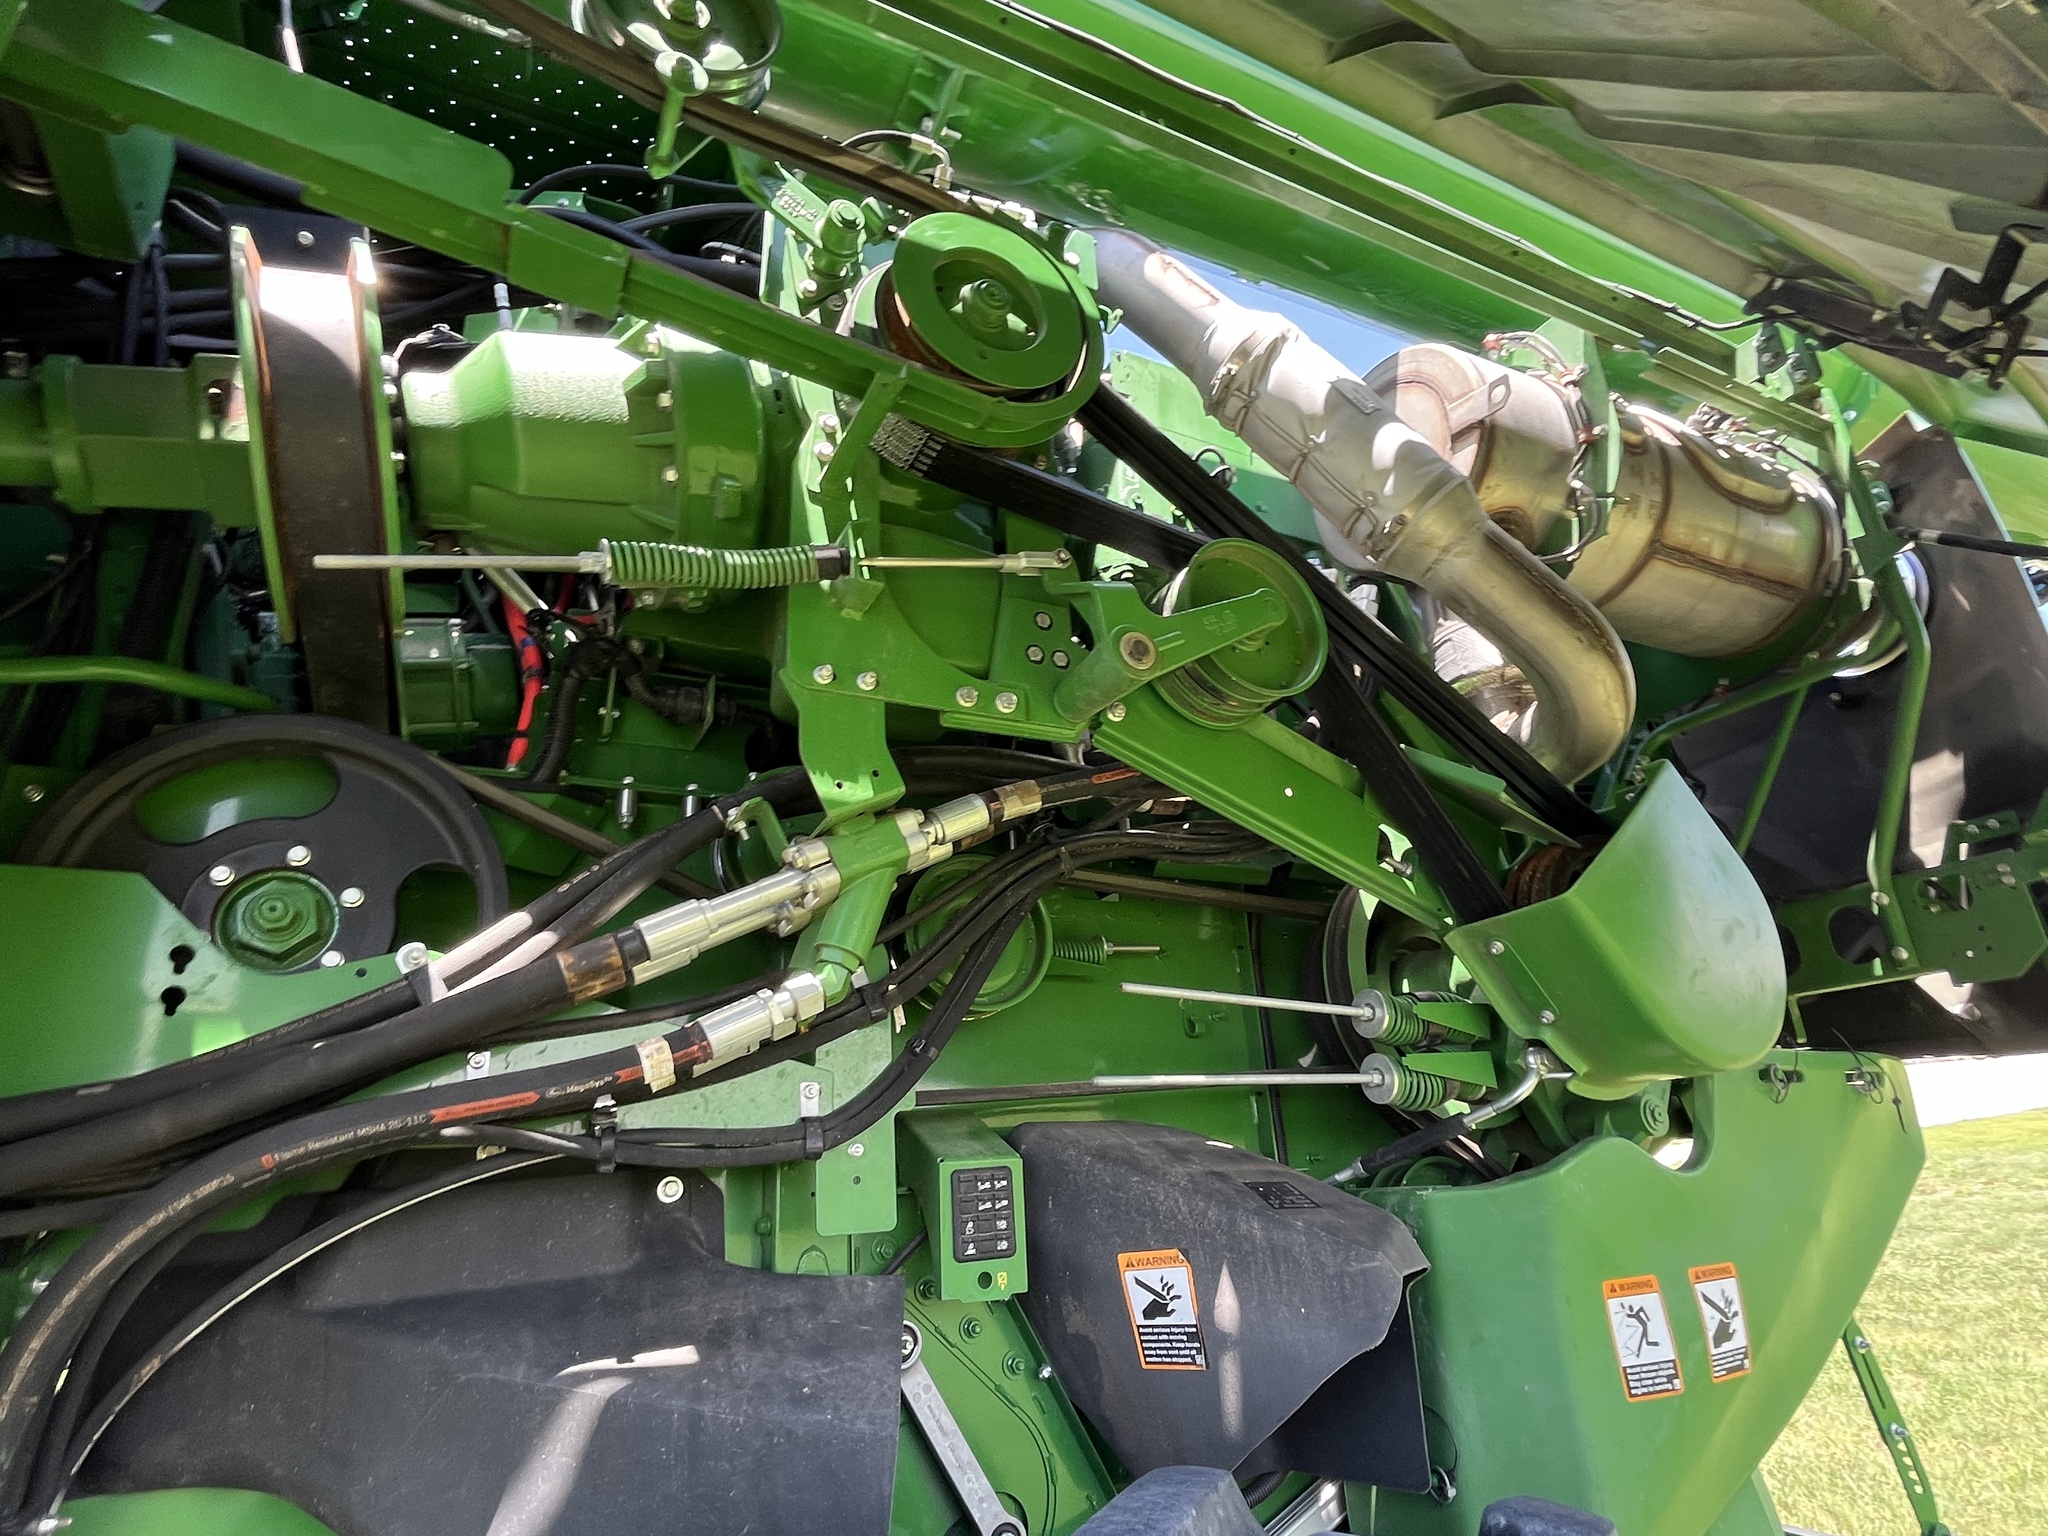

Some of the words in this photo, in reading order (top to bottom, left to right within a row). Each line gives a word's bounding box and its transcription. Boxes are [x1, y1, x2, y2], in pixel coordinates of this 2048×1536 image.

[307, 1131, 353, 1151] Resistant
[357, 1122, 386, 1137] MSHA
[1134, 1255, 1185, 1267] WARNING
[1703, 1265, 1732, 1278] WARNING
[1618, 1279, 1654, 1292] WARNING
